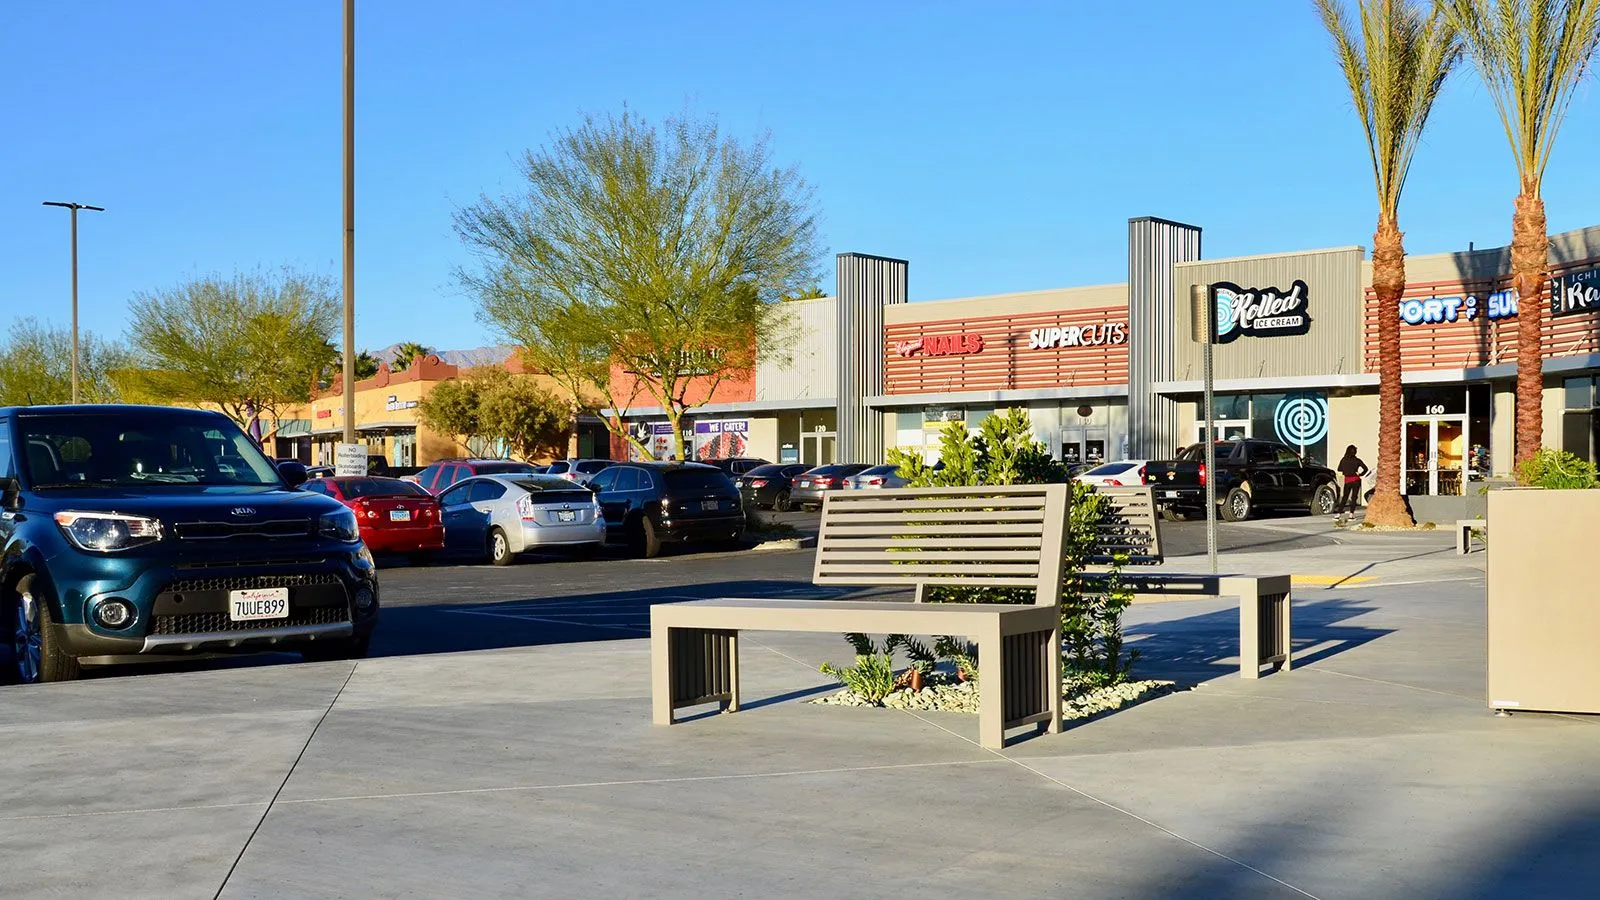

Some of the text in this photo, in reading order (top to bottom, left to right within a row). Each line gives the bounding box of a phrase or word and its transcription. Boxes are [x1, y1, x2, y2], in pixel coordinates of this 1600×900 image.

[1572, 270, 1597, 282] ICHI
[1230, 285, 1301, 329] Rolled
[1270, 318, 1299, 326] CREAM
[1029, 322, 1126, 349] SUPERCUTS
[923, 333, 982, 356] NAILS
[1425, 405, 1445, 415] 160
[709, 423, 719, 432] WE
[235, 599, 285, 616] 7UUE899
